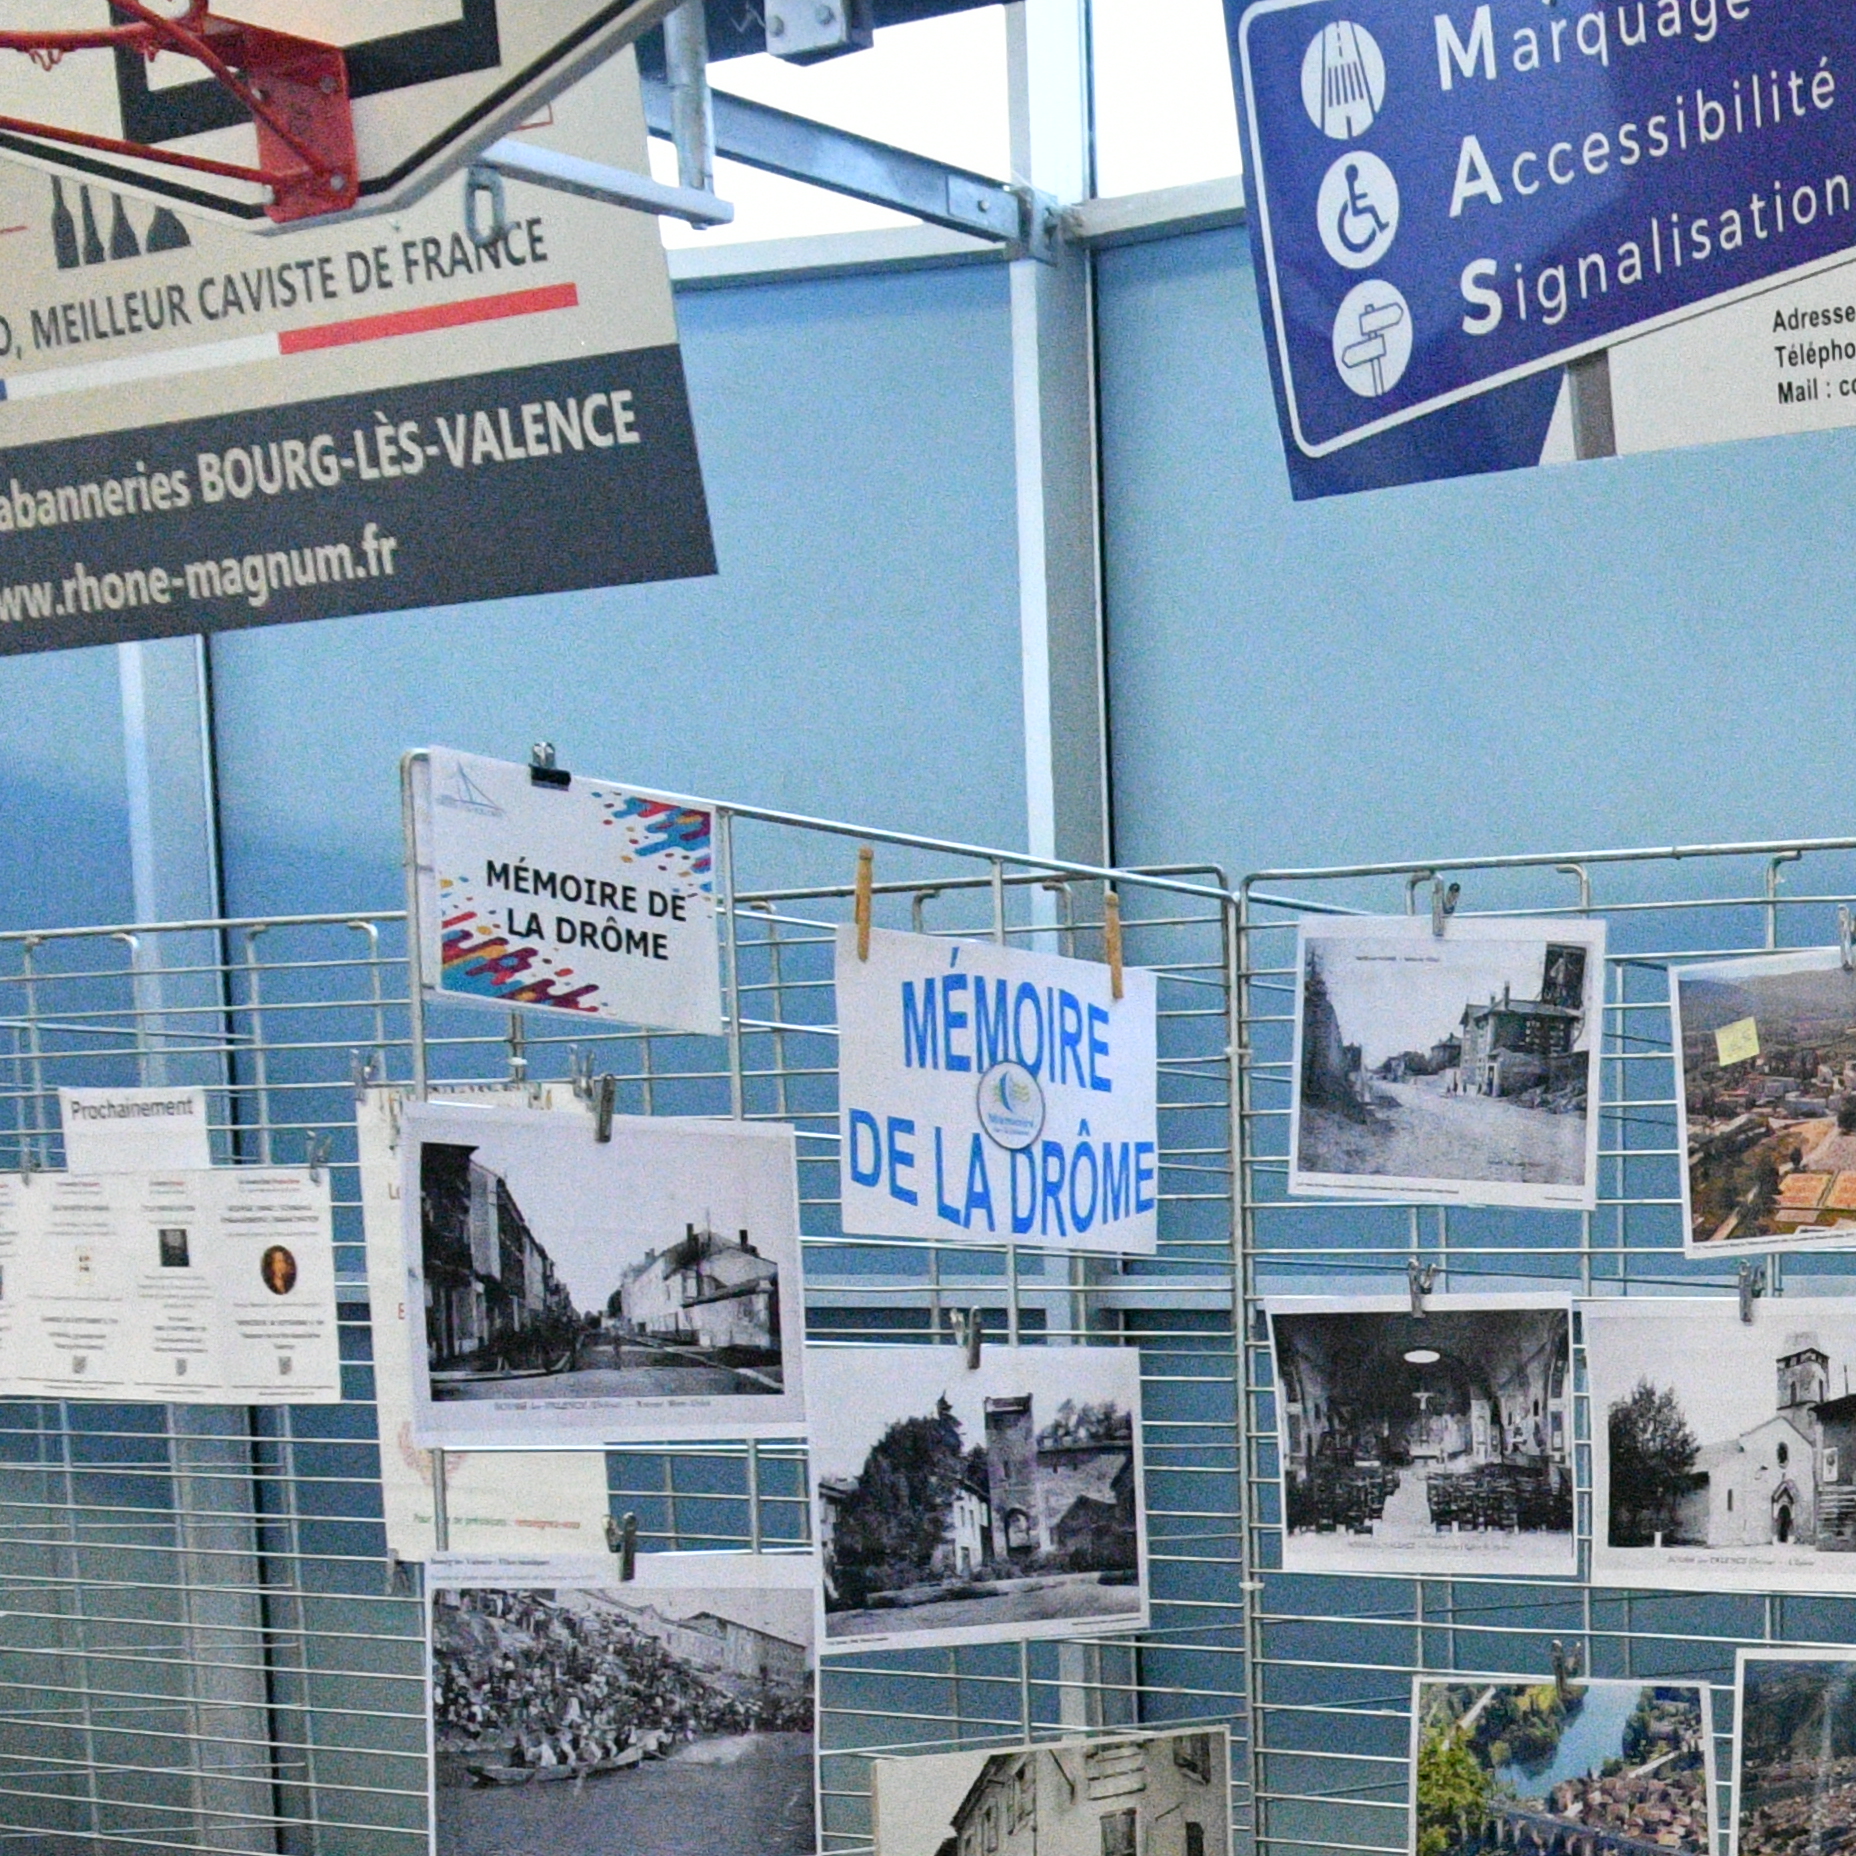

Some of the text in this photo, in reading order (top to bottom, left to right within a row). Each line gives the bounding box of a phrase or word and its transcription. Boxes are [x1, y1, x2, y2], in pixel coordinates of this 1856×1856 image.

[1449, 56, 1836, 218] Accessibilité
[30, 284, 191, 350] MEILLEUR
[198, 256, 338, 320] CAVISTE
[347, 245, 393, 294] DE
[1459, 172, 1852, 336] Signalisation
[1772, 304, 1856, 333] Adresse
[1777, 378, 1819, 405] Mail
[197, 389, 641, 503] BOURG-LÈS-VALENCE
[486, 856, 687, 922] MÉMOIRE DE
[507, 907, 669, 961] LA DRÔME
[901, 946, 1112, 1093] MÉMOIRE
[71, 1097, 193, 1121] Prochainement
[849, 1107, 1155, 1237] DE LA DRÔME
